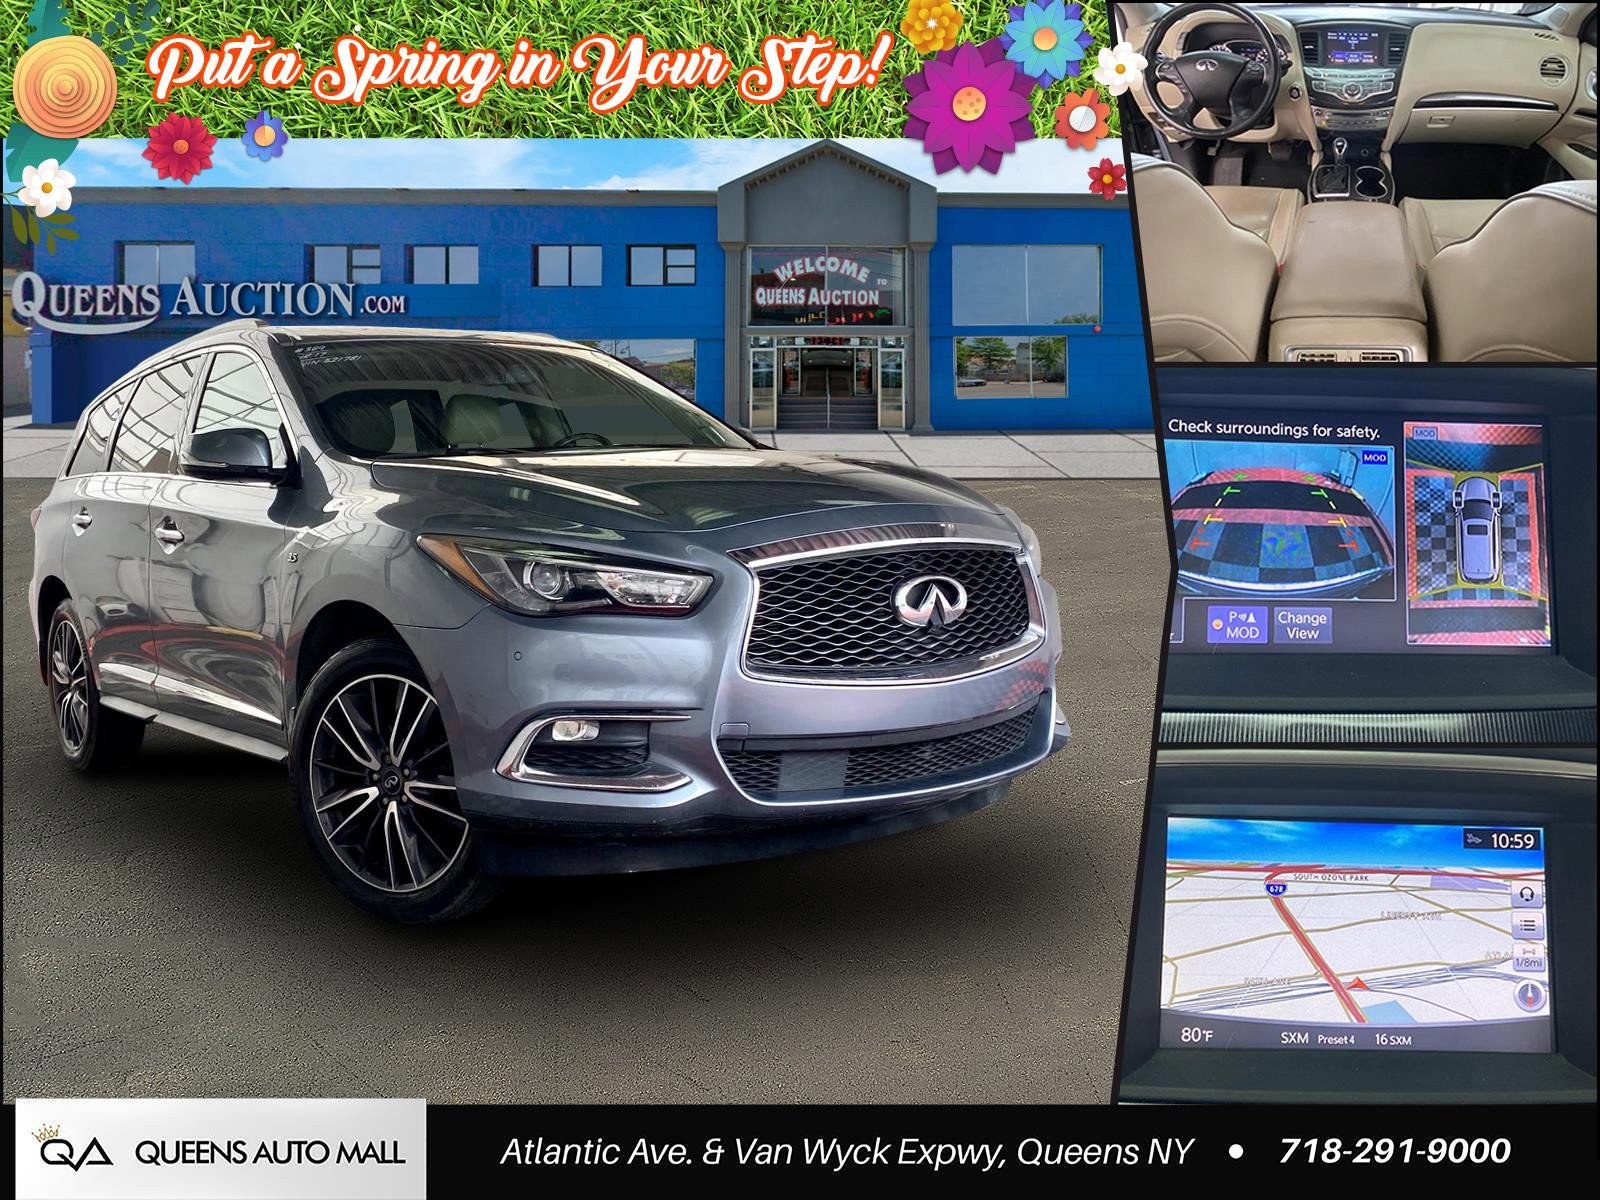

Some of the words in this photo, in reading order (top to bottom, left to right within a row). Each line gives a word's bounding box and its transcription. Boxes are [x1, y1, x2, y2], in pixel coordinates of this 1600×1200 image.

[774, 256, 870, 284] WELCOME
[756, 287, 805, 306] QUEENS
[808, 288, 880, 306] AUCTION
[12, 272, 161, 335] QUEENS
[1168, 419, 1212, 434] Check
[1216, 421, 1309, 439] surroundings
[1312, 425, 1333, 437] for
[1336, 425, 1381, 439] safety.
[1413, 428, 1436, 438] MOD
[1363, 452, 1388, 464] MOD
[1278, 611, 1328, 627] Change
[1226, 626, 1260, 639] MOD
[1287, 628, 1320, 640] View
[1491, 832, 1535, 849] 10:59
[1293, 873, 1319, 881] SOUTH
[1321, 873, 1347, 882] OZONE
[1349, 874, 1369, 882] PARK
[1269, 885, 1285, 894] 678
[1280, 1032, 1309, 1045] SXM
[1318, 1034, 1348, 1045] Preset
[1375, 1033, 1388, 1046] 16
[1390, 1036, 1412, 1046] SXM
